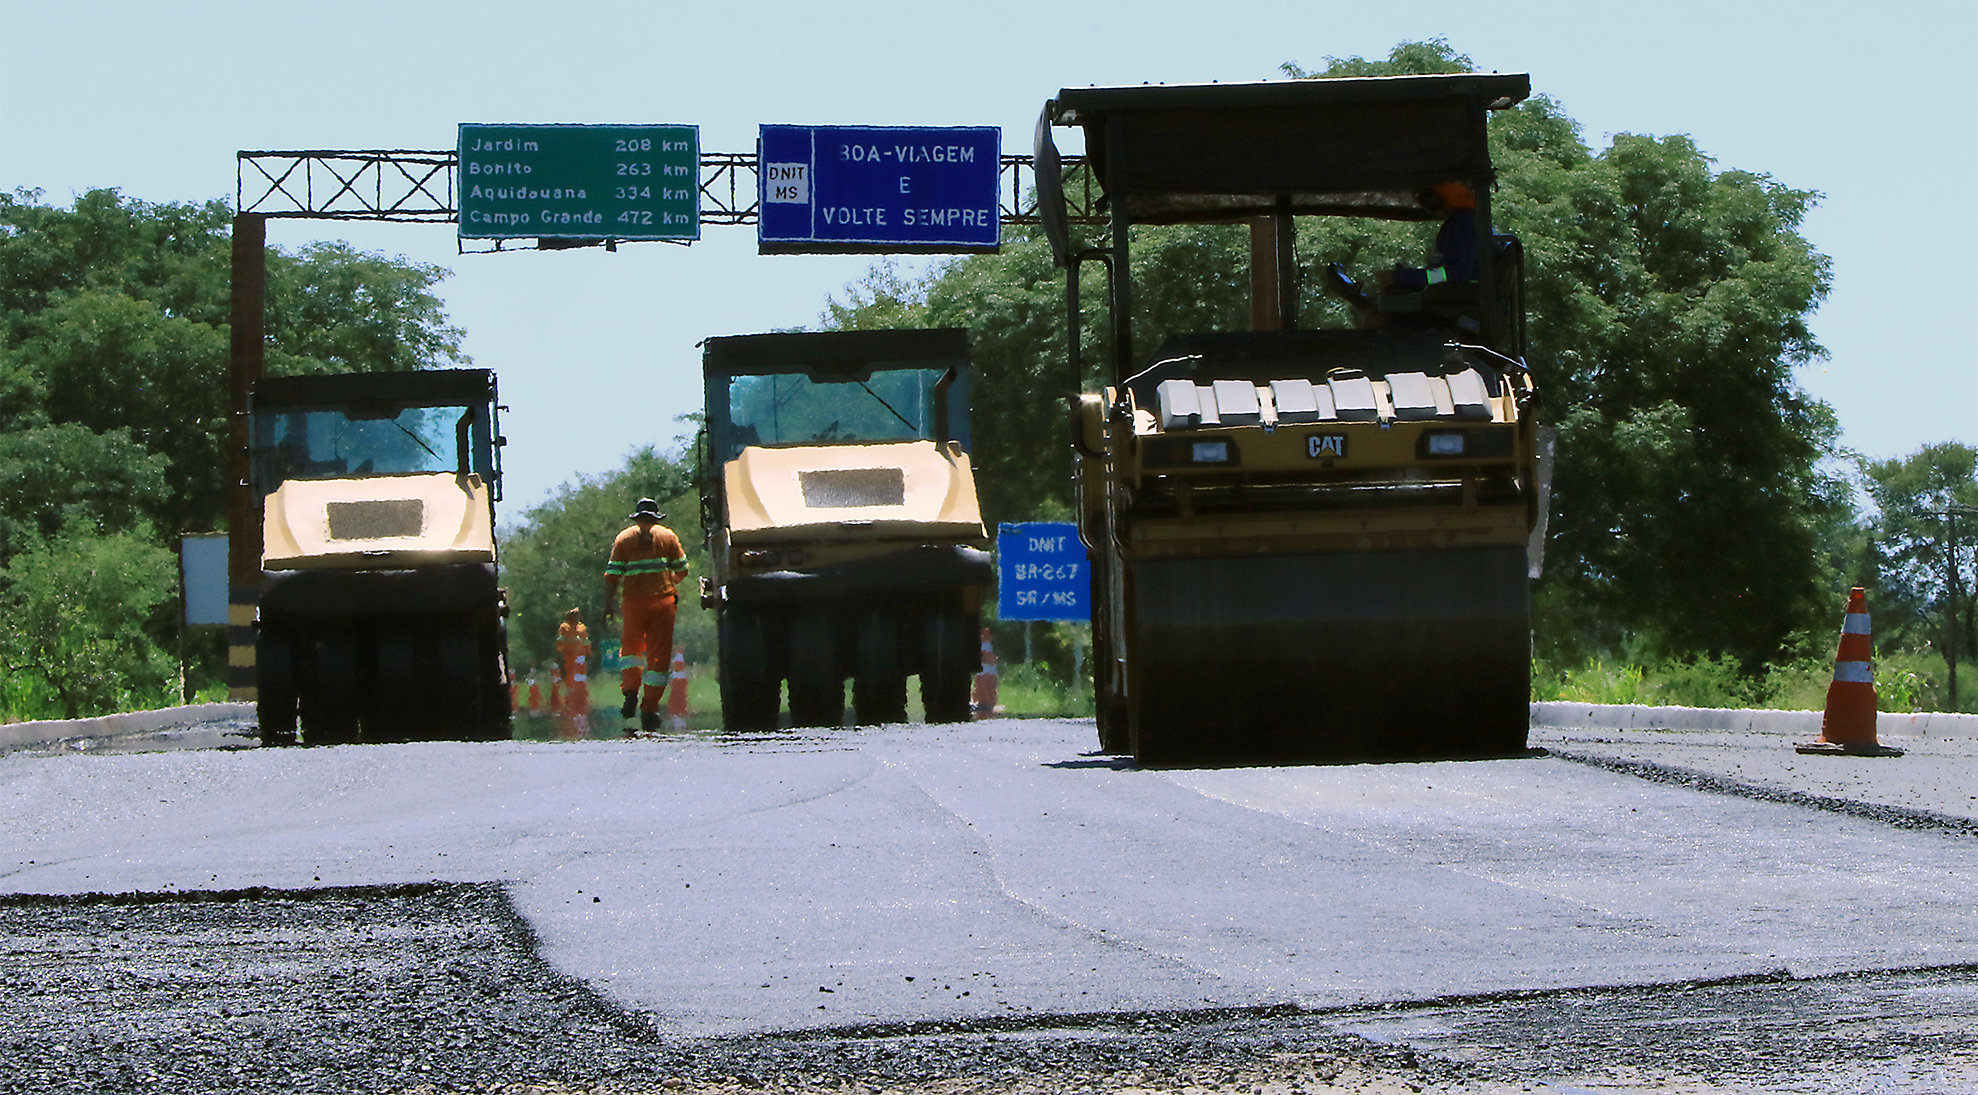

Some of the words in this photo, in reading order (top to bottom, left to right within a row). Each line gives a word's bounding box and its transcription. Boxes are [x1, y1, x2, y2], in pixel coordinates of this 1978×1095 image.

[471, 139, 538, 152] Jardim
[616, 139, 651, 152] 208
[662, 139, 688, 152] km
[840, 144, 974, 163] BOA-VIAGEM
[469, 162, 532, 175] Bonito
[617, 163, 651, 176] 263
[663, 164, 688, 176] km
[769, 167, 804, 181] DNIT
[776, 186, 798, 200] MS
[900, 176, 911, 194] E
[615, 187, 651, 200] 334
[662, 187, 689, 200] km
[470, 210, 530, 226] Campo
[541, 210, 602, 224] Grande
[618, 211, 653, 225] 472
[662, 211, 689, 225] km
[823, 207, 887, 226] VOLTE
[903, 209, 988, 227] SEMPRE
[1308, 436, 1344, 458] CAT
[1015, 563, 1079, 580] BR-267
